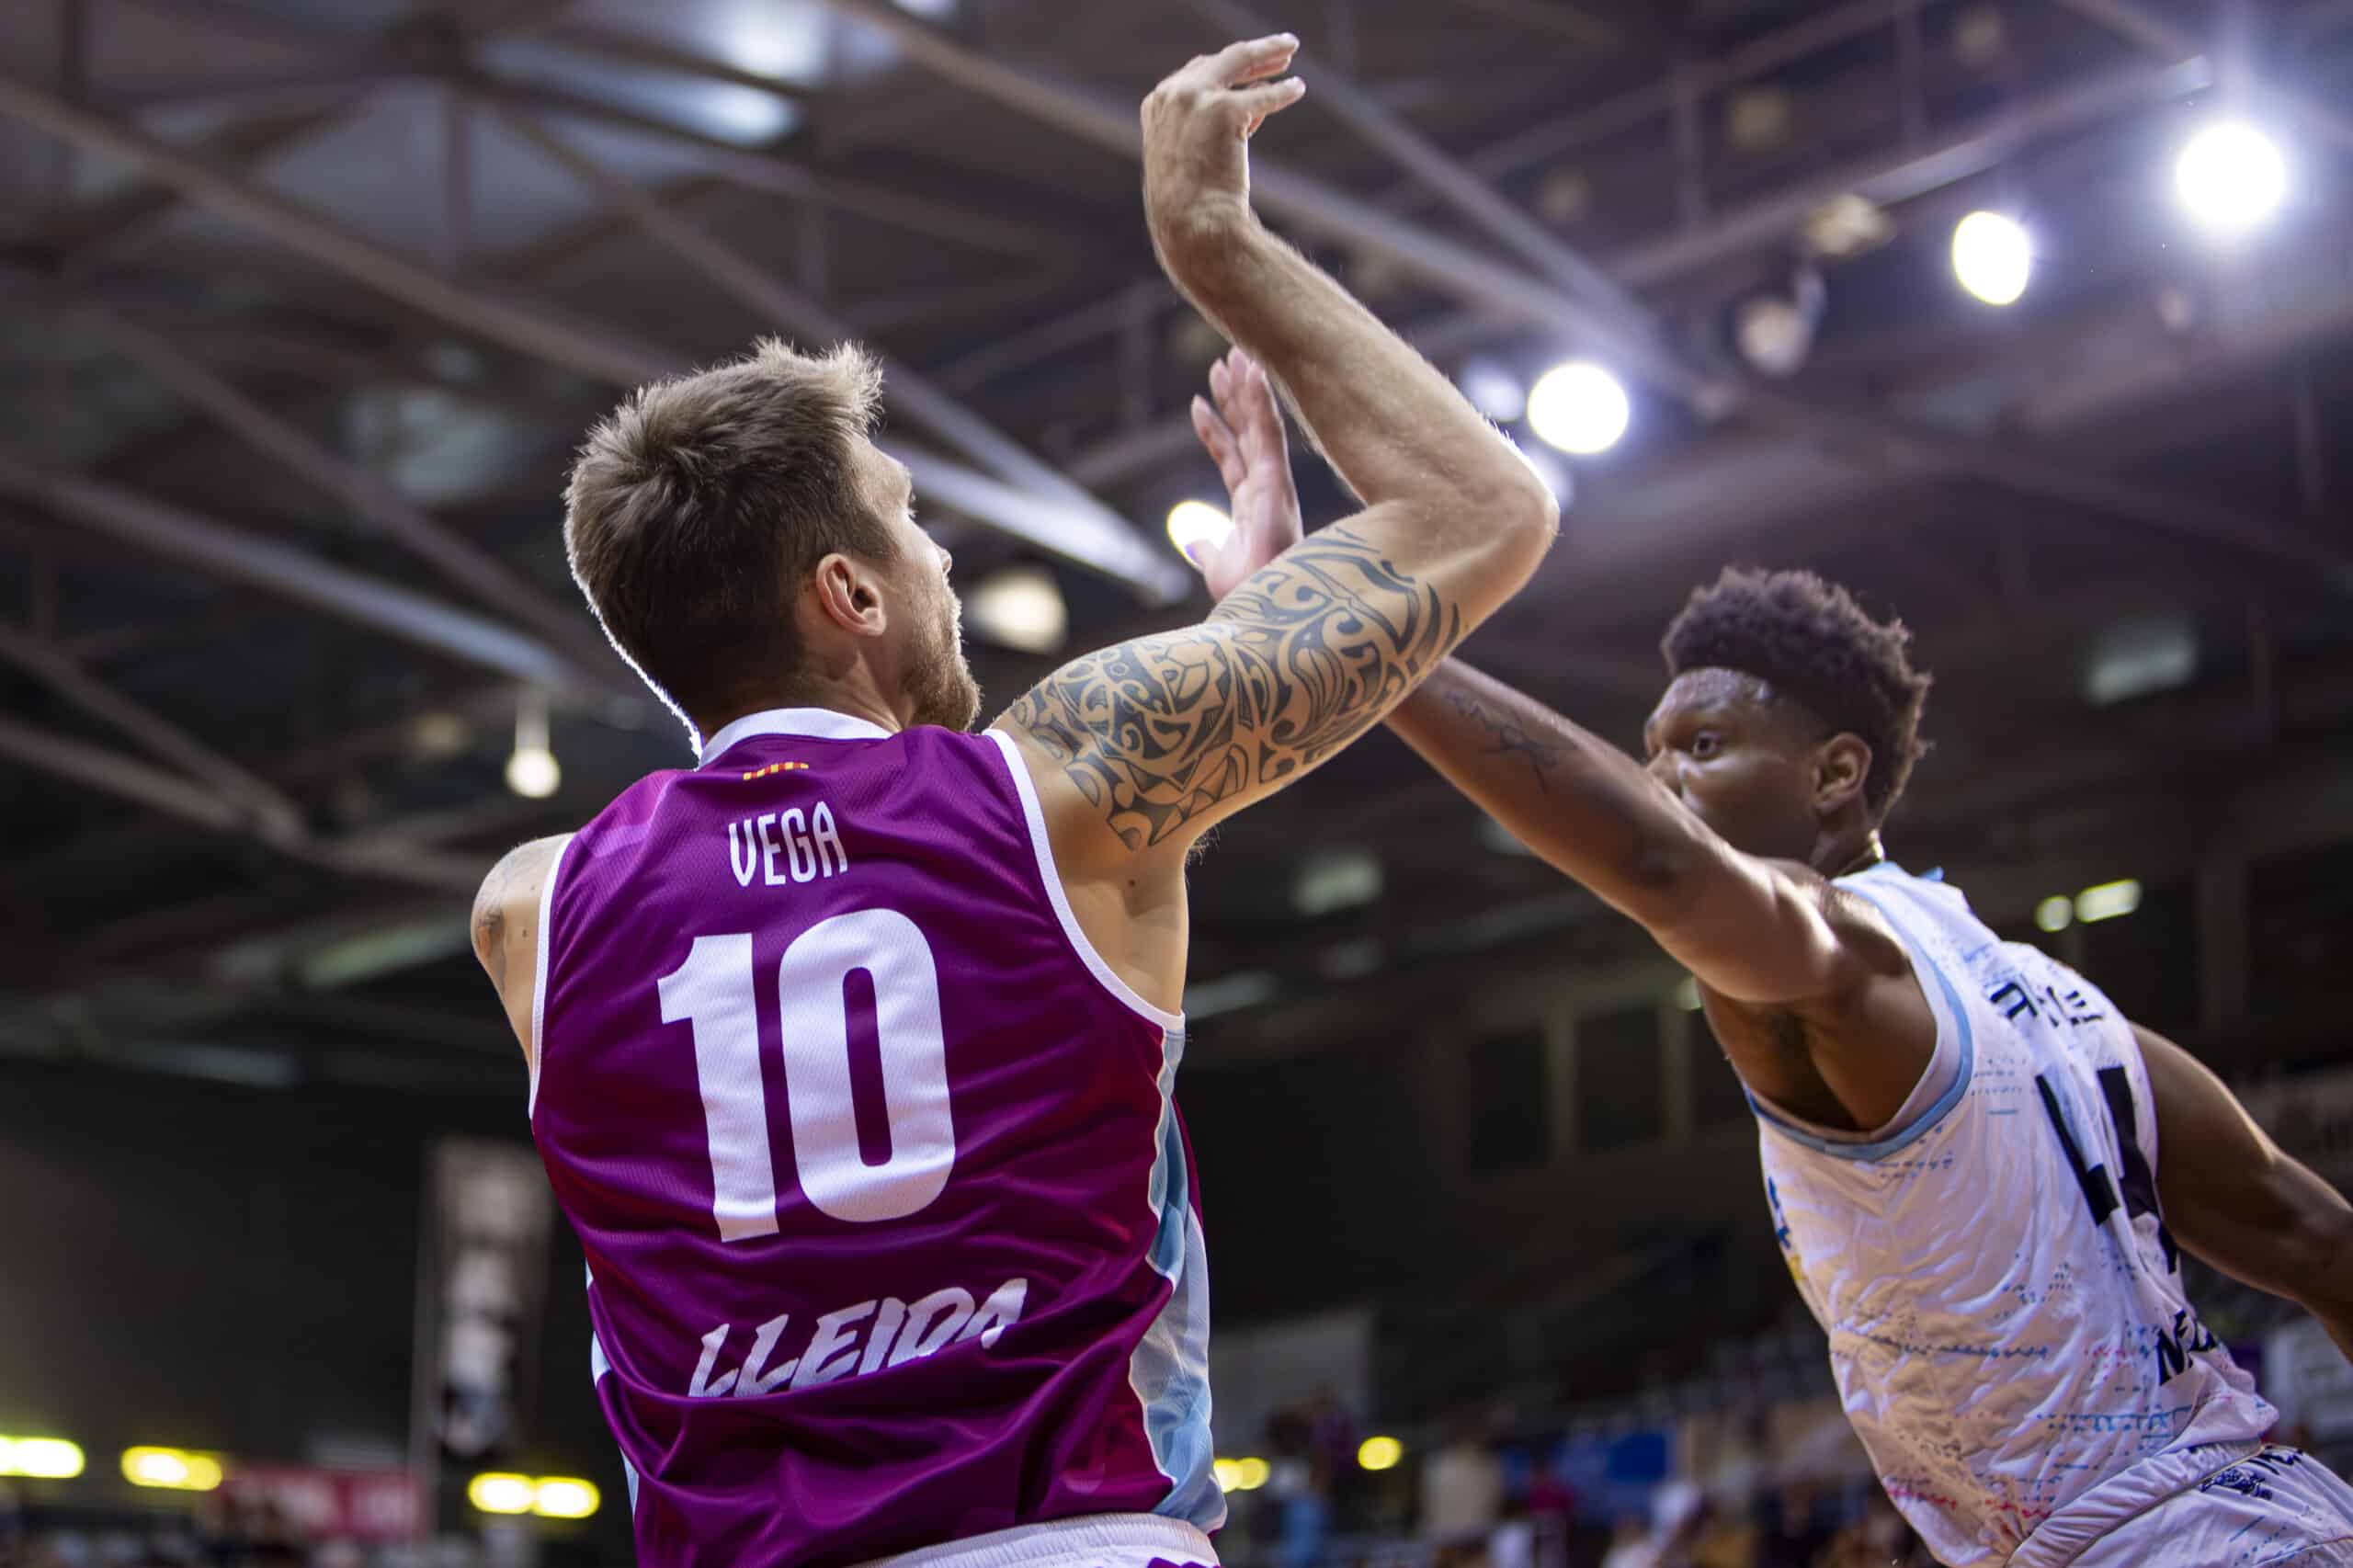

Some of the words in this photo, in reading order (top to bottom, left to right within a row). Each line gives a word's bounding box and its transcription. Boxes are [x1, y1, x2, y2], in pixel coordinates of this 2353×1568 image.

[729, 801, 847, 887] VEGA
[657, 908, 956, 1242] 10
[688, 1278, 1028, 1397] LLEIDA
